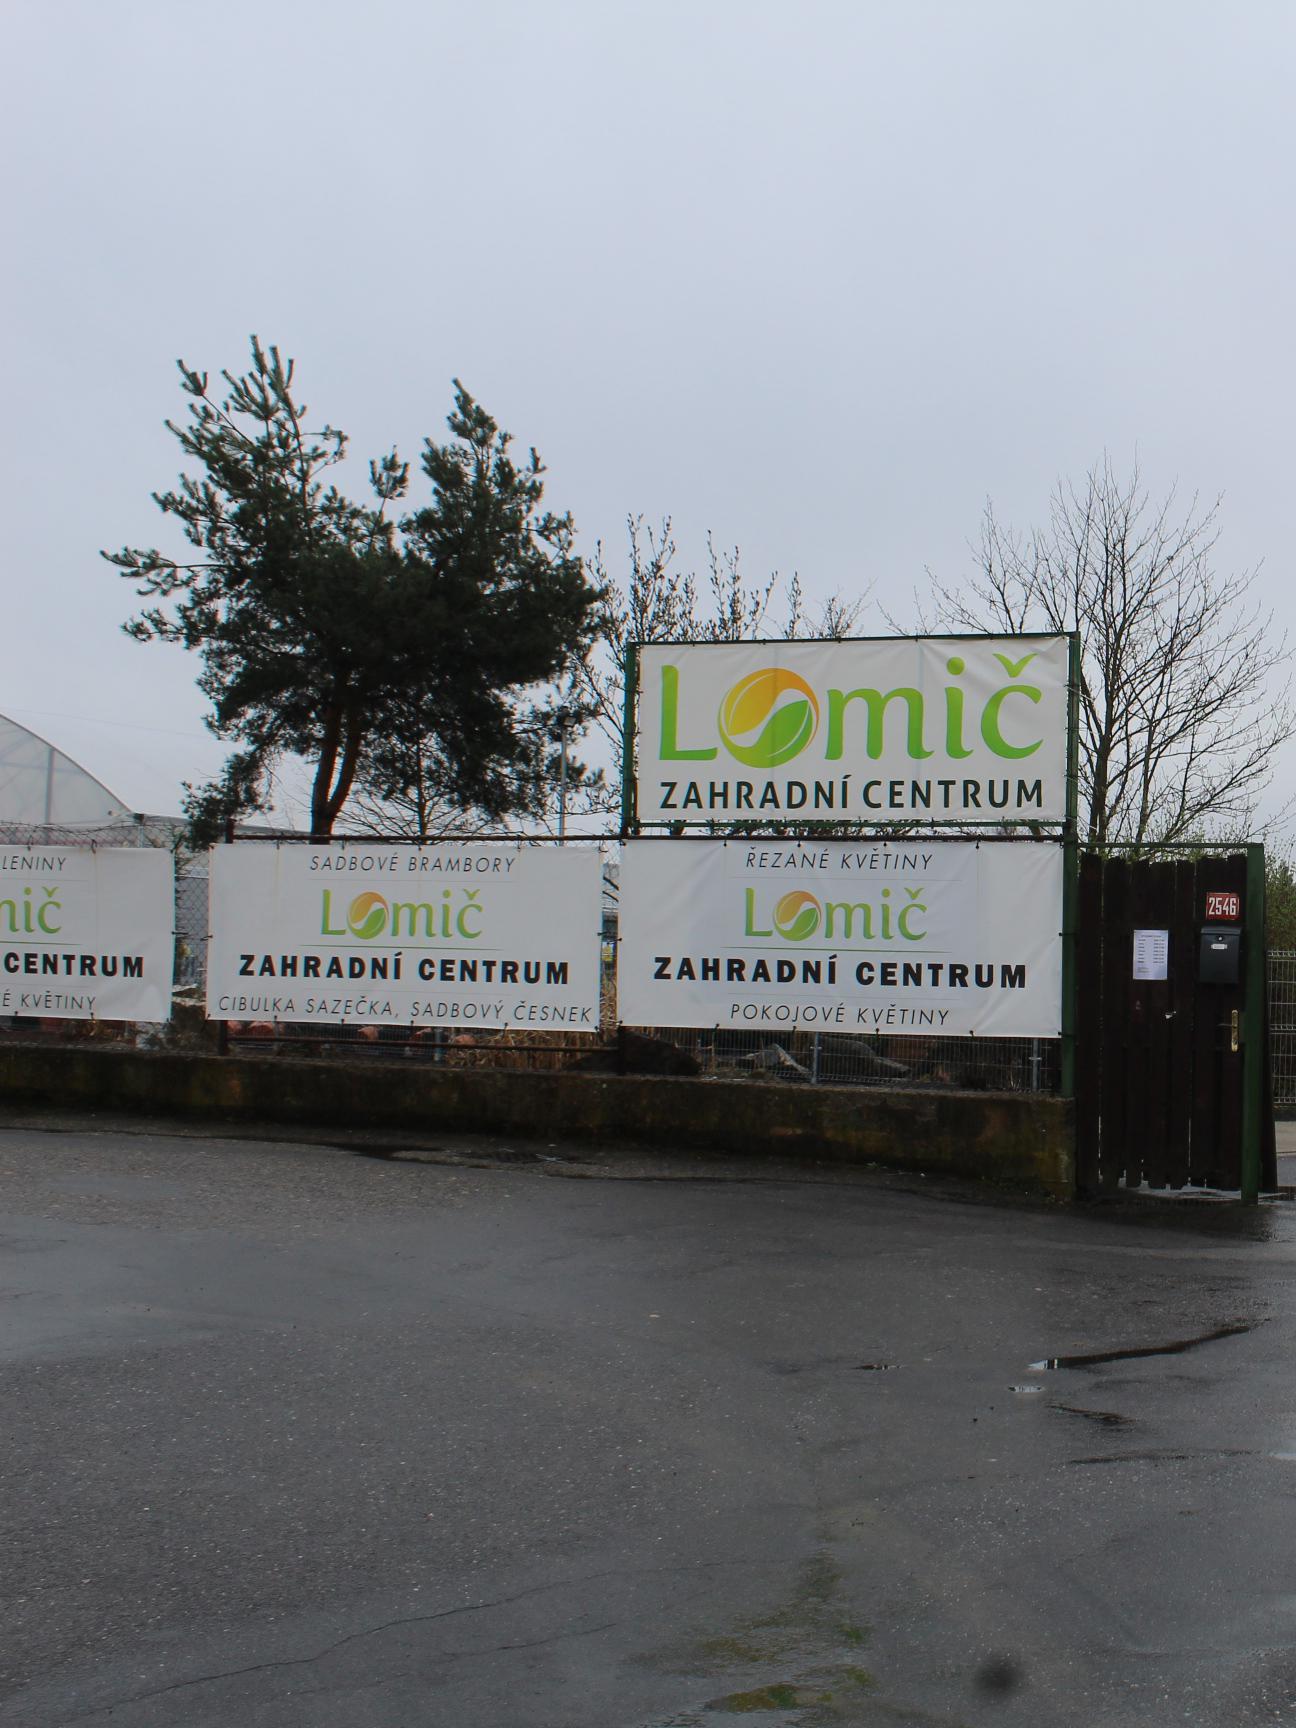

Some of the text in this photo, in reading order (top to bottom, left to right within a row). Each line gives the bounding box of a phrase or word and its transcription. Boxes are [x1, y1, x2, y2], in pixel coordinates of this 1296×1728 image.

[658, 653, 1044, 769] Lomič
[659, 774, 1043, 809] ZAHRADNÍ CENTRUM
[0, 855, 66, 871] LENINY
[309, 853, 516, 873] SADBOVÉ BRAMBORY
[745, 847, 934, 870] ŘEZANÉ KVĚTINY
[320, 888, 485, 940] Lomič
[744, 887, 928, 942] Lomič
[1208, 897, 1237, 916] 2546
[3, 952, 145, 978] CENTRUM
[238, 951, 569, 984] ZAHRADNÍ CENTRUM
[653, 954, 1027, 989] ZAHRADNÍ CENTRUM
[20, 990, 96, 1010] KVĚTINY
[218, 995, 592, 1022] CIBULKA SAZEČKA, SADBOVÝ ČESNEK
[730, 1002, 950, 1025] POKOJOVÉ KVĚTINY
